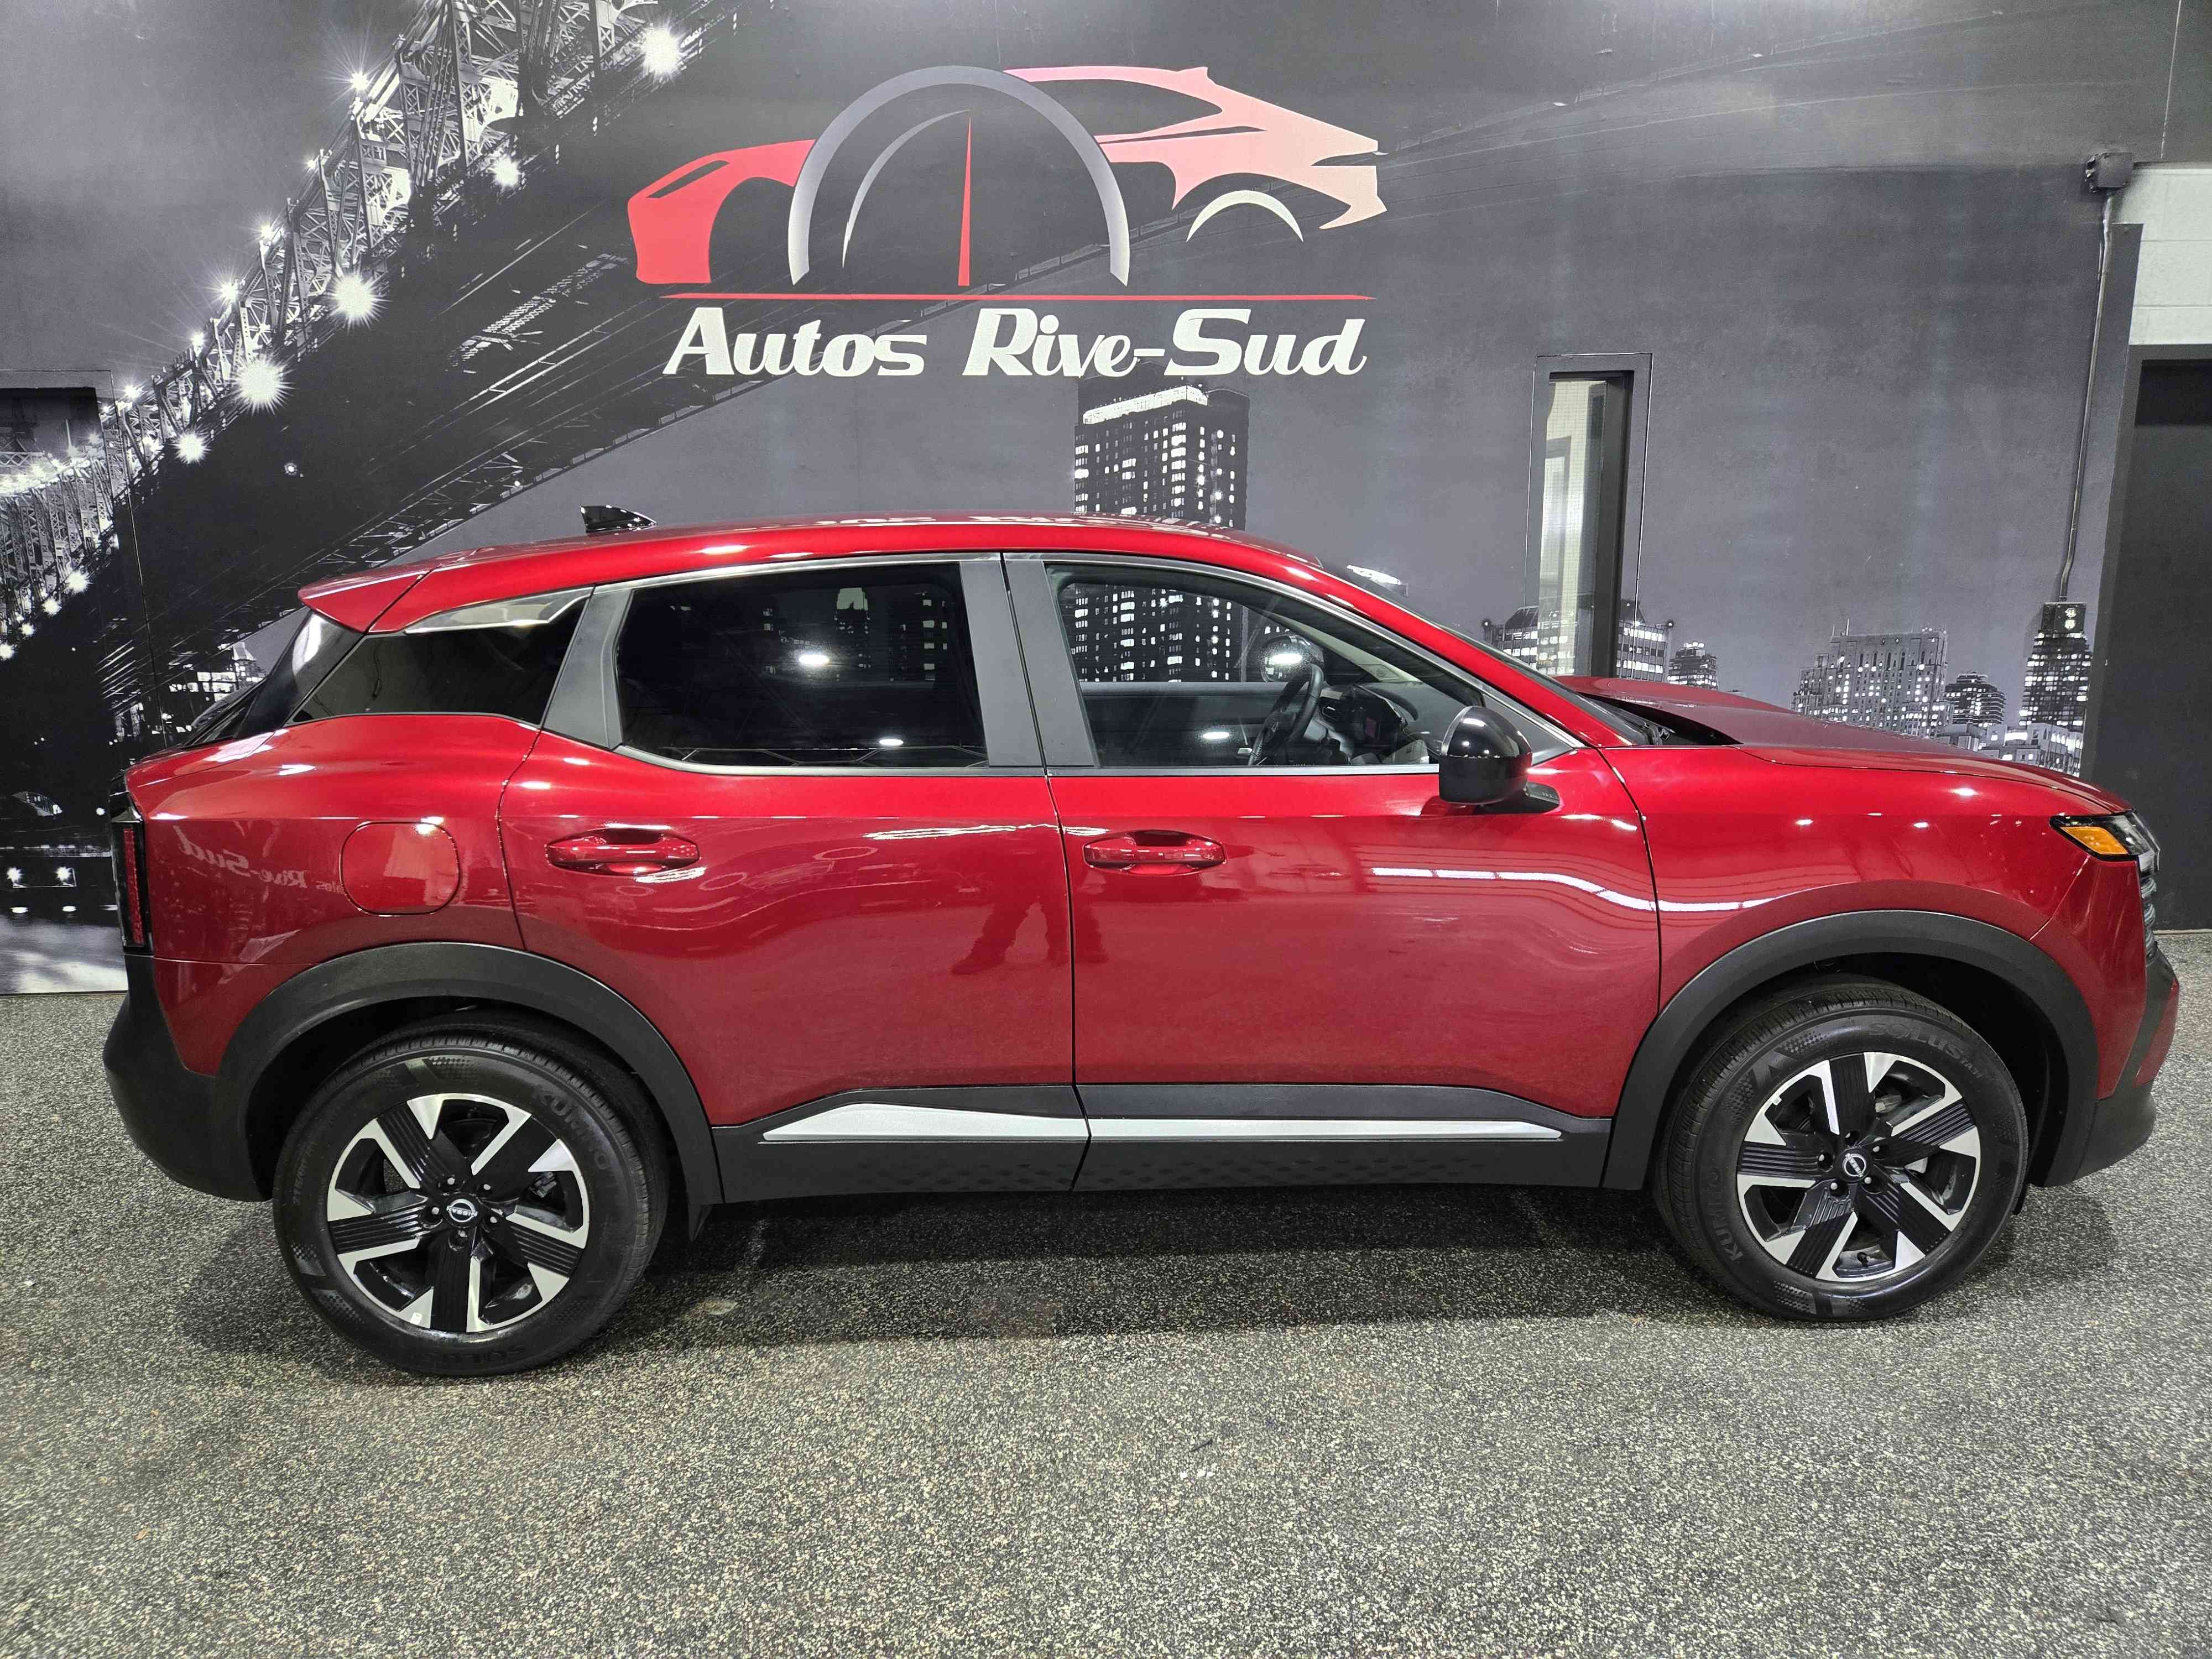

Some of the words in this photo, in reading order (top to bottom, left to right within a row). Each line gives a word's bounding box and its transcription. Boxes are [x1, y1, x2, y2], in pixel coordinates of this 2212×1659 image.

[662, 307, 927, 377] Autos
[962, 308, 1368, 378] Rive-Sud
[1867, 1023, 1963, 1059] SOLUS
[1845, 1153, 1864, 1177] NISSAN
[446, 1206, 478, 1217] NISSAN
